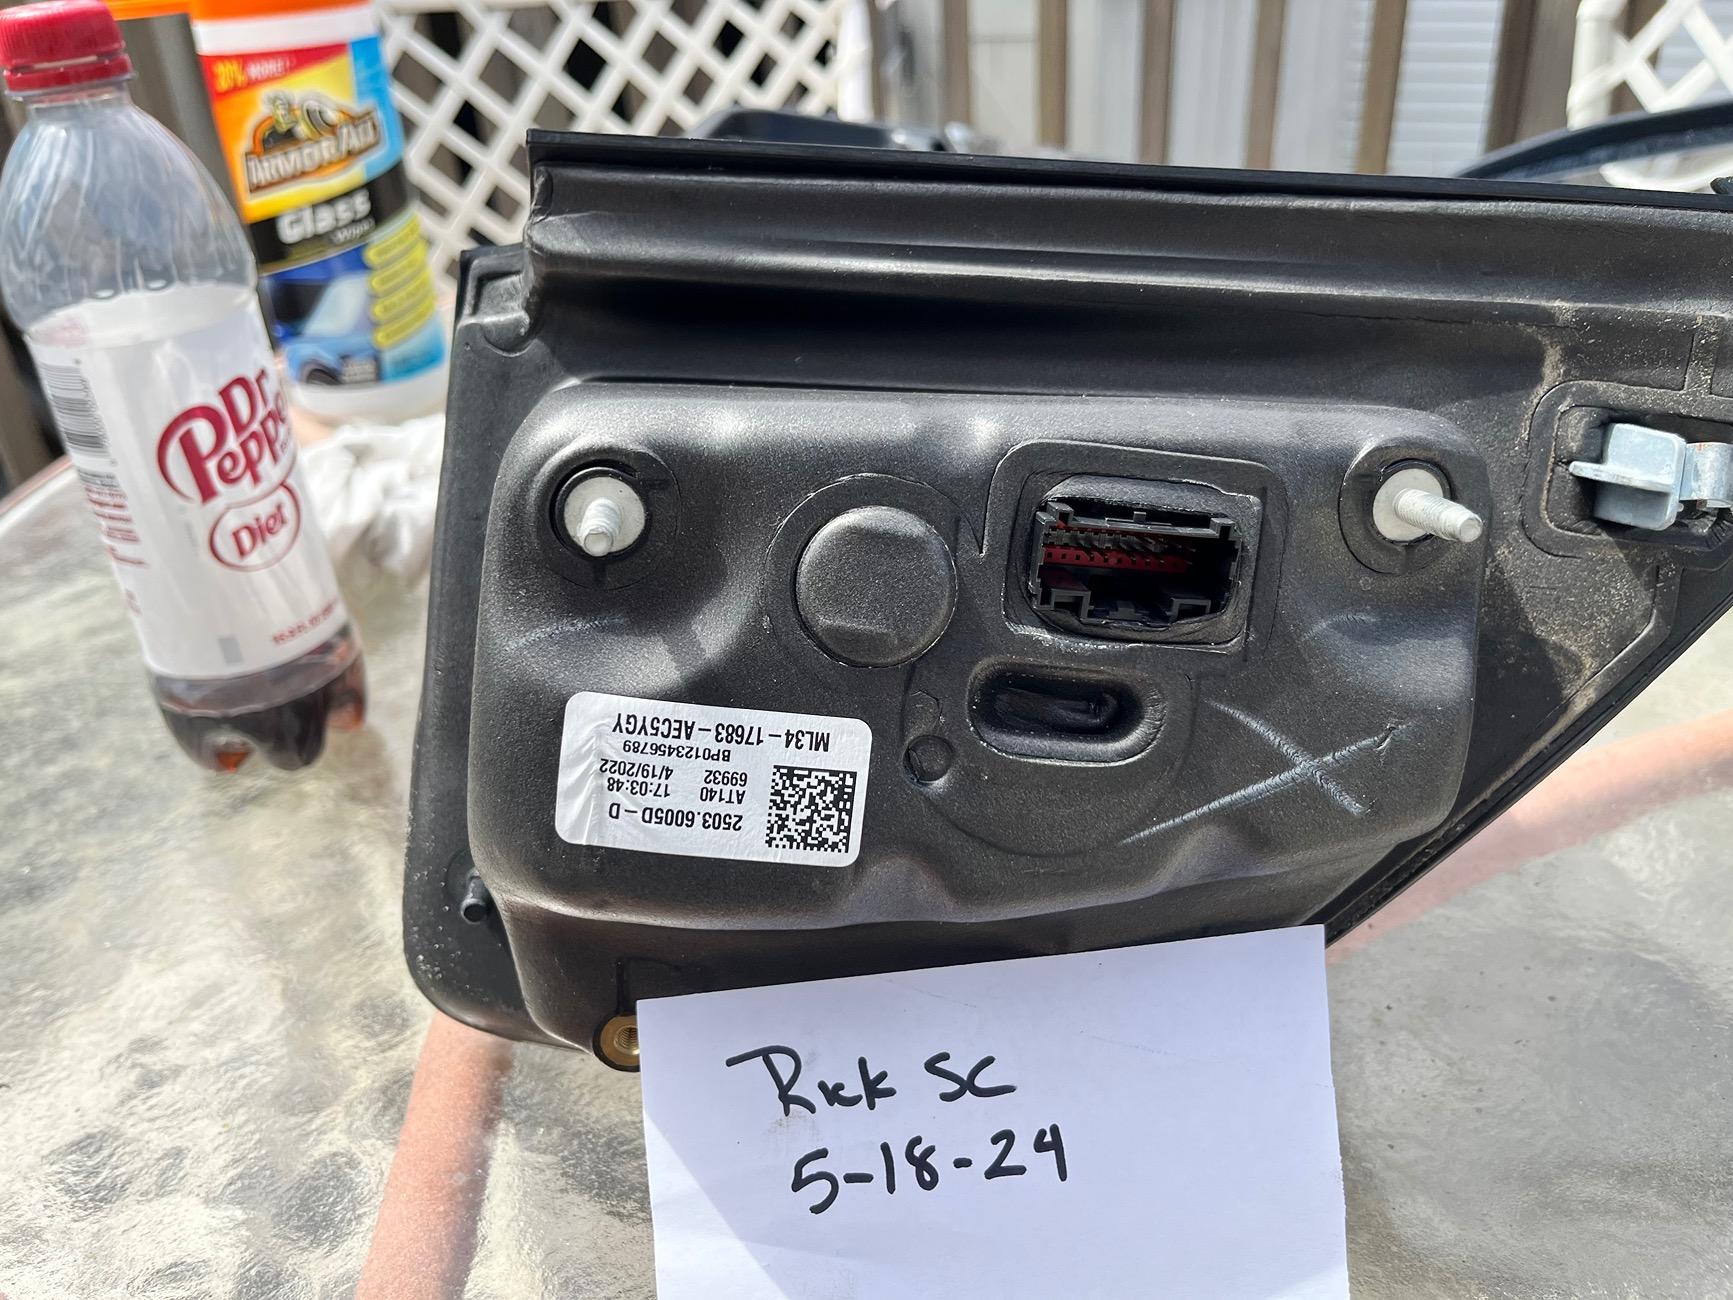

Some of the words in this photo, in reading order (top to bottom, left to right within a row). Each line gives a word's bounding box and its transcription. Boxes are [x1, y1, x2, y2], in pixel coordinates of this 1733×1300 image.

[277, 188, 371, 244] Glass
[218, 368, 269, 439] Dr
[232, 503, 288, 559] Diet
[599, 758, 673, 781] 4/19/2022
[622, 739, 731, 763] BP0123456789
[606, 776, 671, 798] 17:03:48
[700, 785, 746, 804] AT140
[703, 768, 748, 787] 69932
[725, 1044, 897, 1118] Rick
[790, 1122, 1069, 1215] 5-18-24
